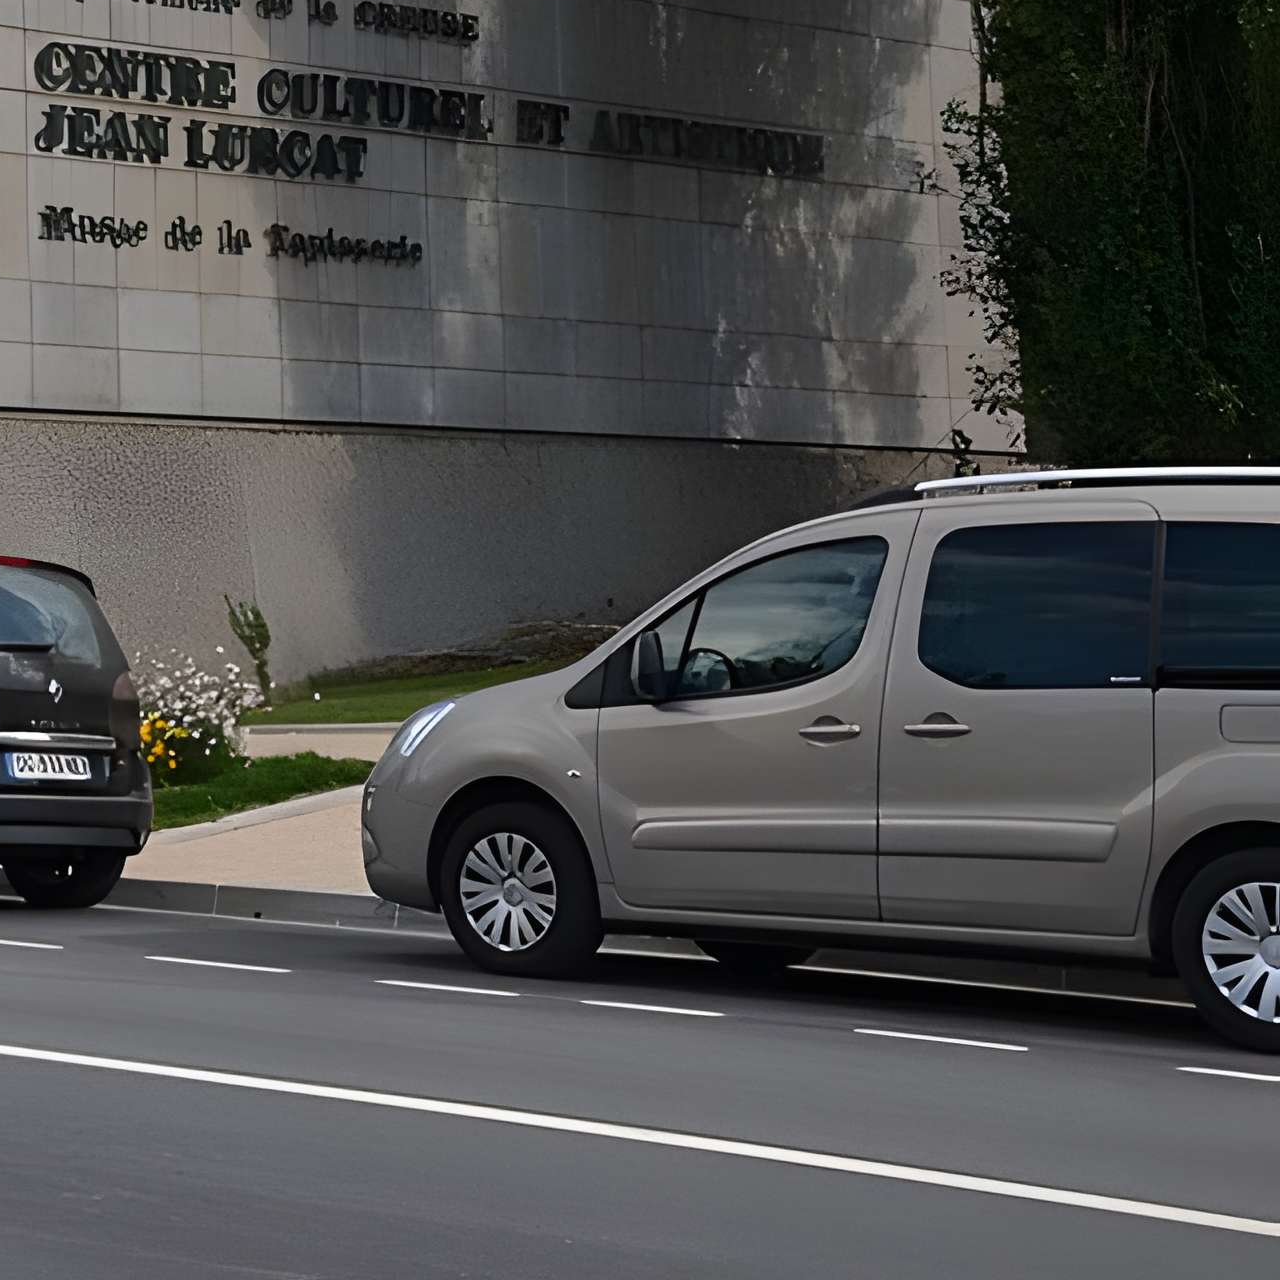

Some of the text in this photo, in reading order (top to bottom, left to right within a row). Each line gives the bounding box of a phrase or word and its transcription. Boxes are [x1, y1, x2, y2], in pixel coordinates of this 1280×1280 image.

[34, 41, 237, 109] CENTRE
[257, 68, 493, 141] CULTUREL
[516, 99, 570, 145] ET
[35, 104, 171, 164] JEAN
[164, 216, 203, 251] de
